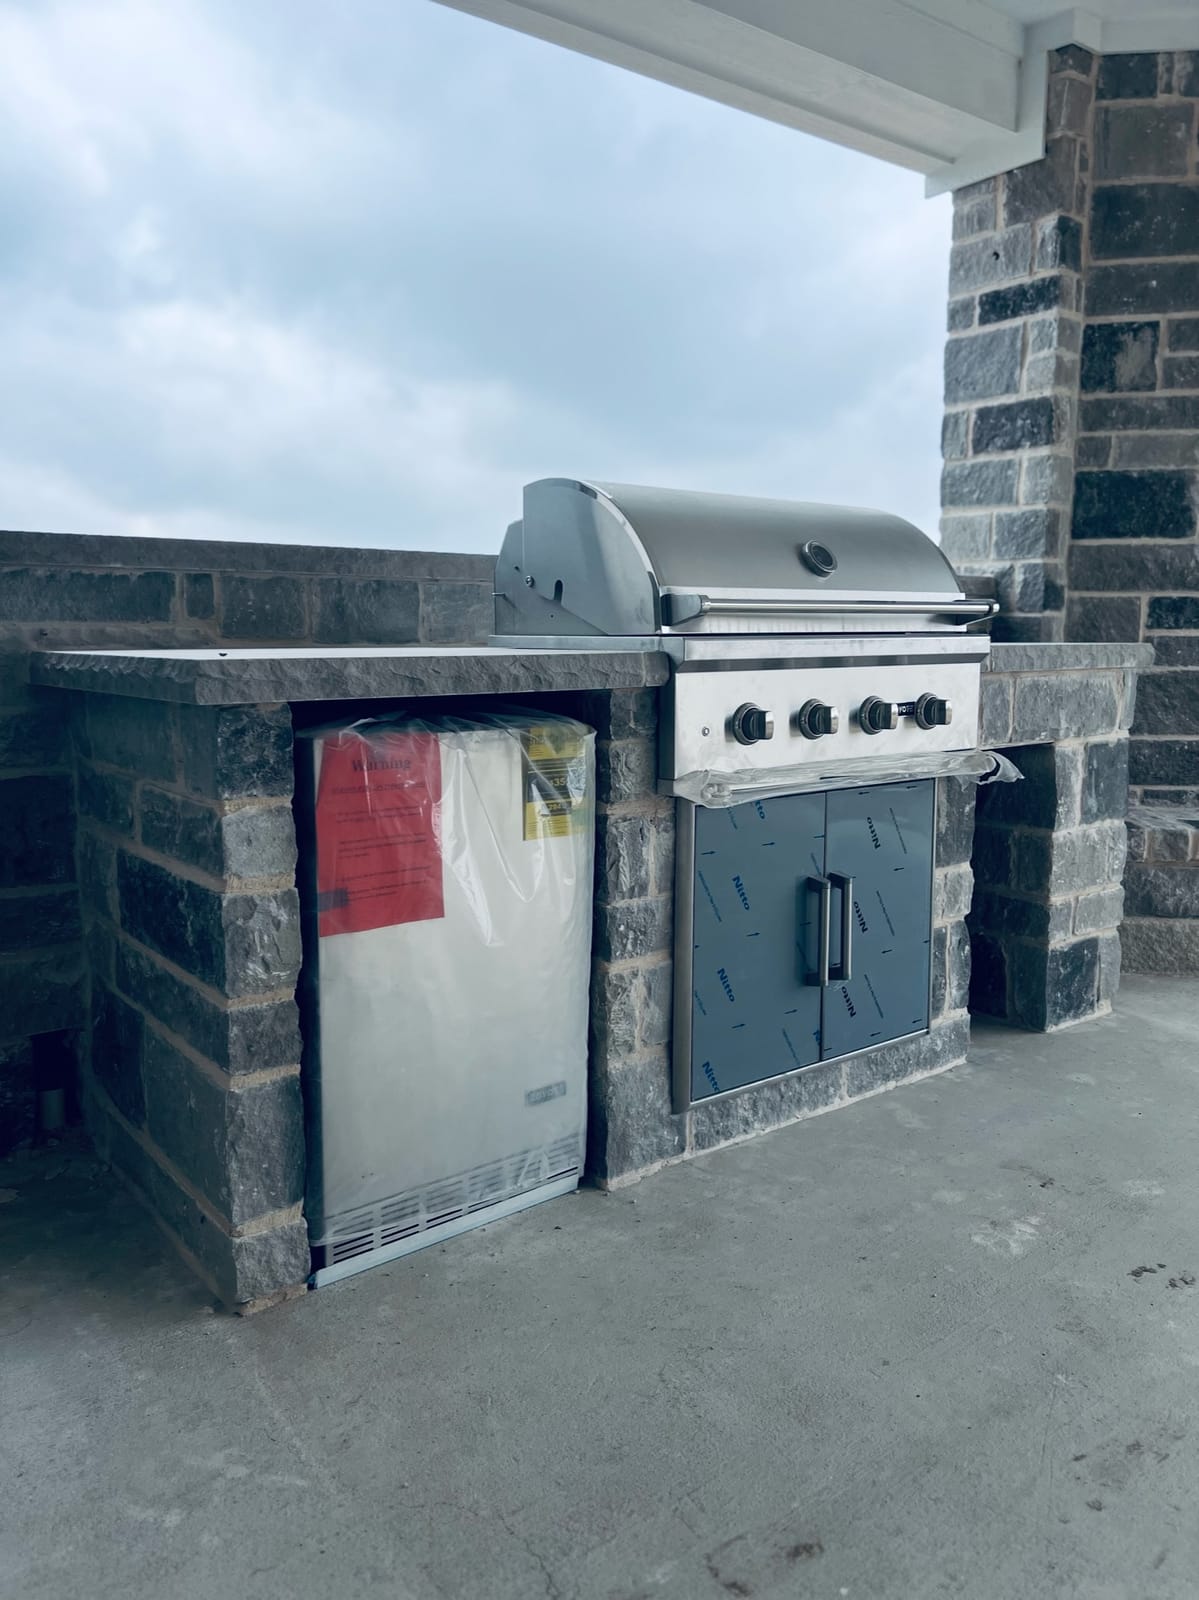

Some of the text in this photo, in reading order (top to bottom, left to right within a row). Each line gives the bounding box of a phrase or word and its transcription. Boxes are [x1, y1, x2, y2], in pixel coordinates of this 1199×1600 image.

[352, 758, 411, 773] Warning
[755, 800, 765, 820] tto
[866, 816, 881, 850] Nitto
[731, 874, 751, 912] Nitto
[853, 900, 869, 934] Nitto
[716, 967, 736, 1003] Nitto
[841, 985, 857, 1018] Nitto
